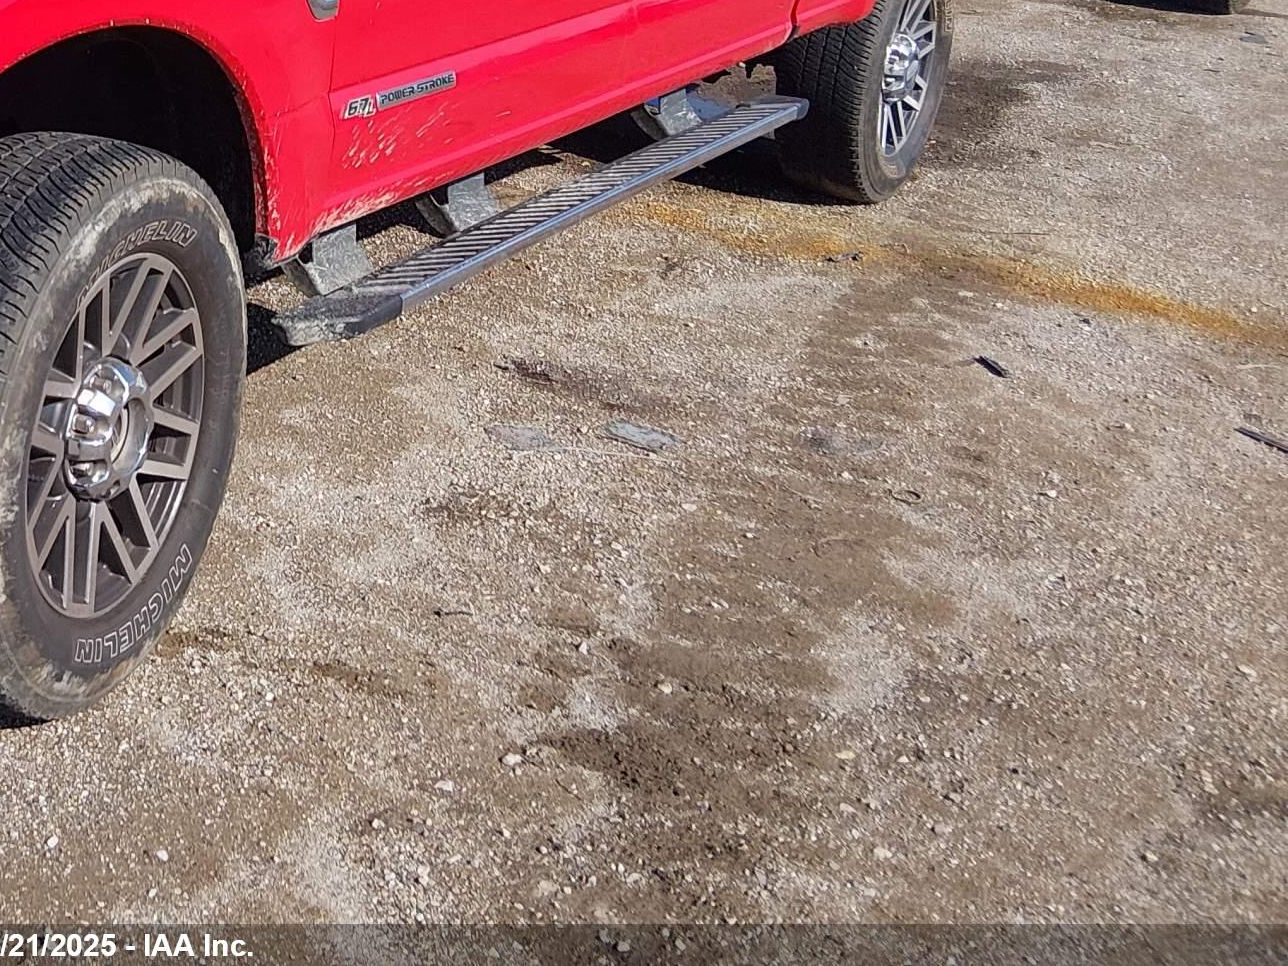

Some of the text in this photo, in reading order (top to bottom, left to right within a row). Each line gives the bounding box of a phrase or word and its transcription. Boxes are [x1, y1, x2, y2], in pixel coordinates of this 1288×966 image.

[379, 86, 415, 105] POWER
[416, 74, 455, 93] STROKE
[74, 543, 193, 664] MICHELIN
